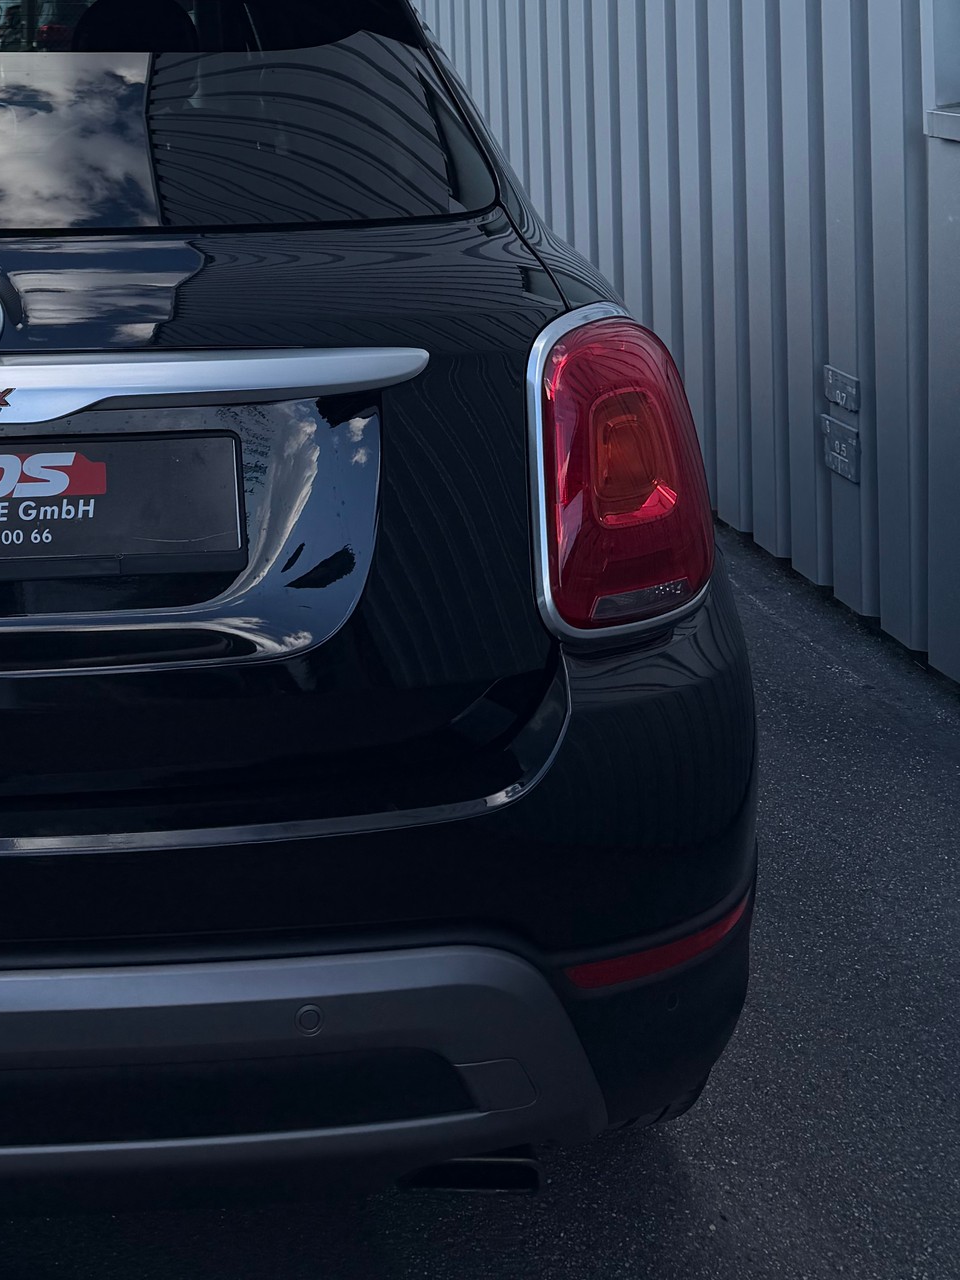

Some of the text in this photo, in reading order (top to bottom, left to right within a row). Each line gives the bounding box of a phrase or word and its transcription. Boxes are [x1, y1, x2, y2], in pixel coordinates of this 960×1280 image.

[18, 499, 95, 521] GmbH
[1, 529, 24, 545] 00
[30, 528, 53, 544] 66
